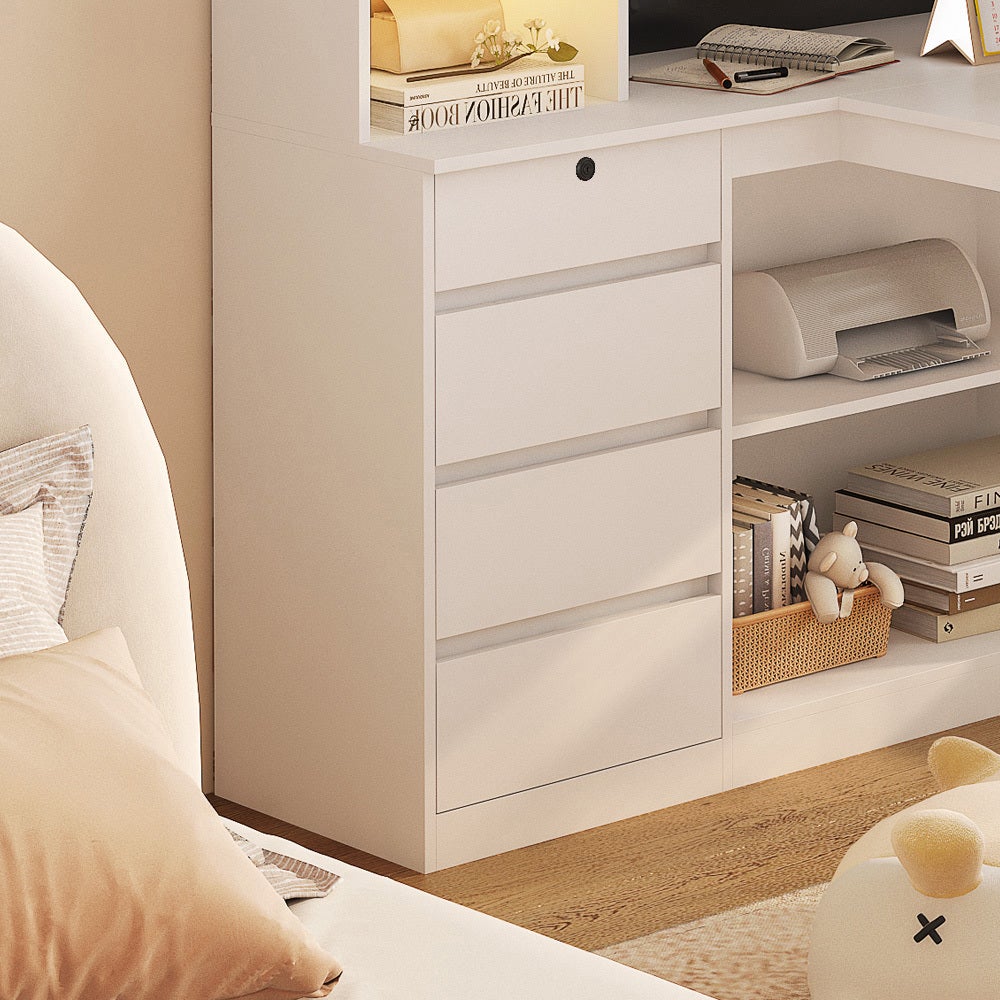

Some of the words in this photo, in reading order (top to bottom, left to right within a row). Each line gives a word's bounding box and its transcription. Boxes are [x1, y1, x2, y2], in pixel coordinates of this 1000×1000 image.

[524, 73, 556, 85] ALLURE
[557, 70, 575, 81] THE
[475, 80, 510, 92] BEAUTY
[511, 77, 523, 87] OF
[954, 518, 974, 539] РЭЙ
